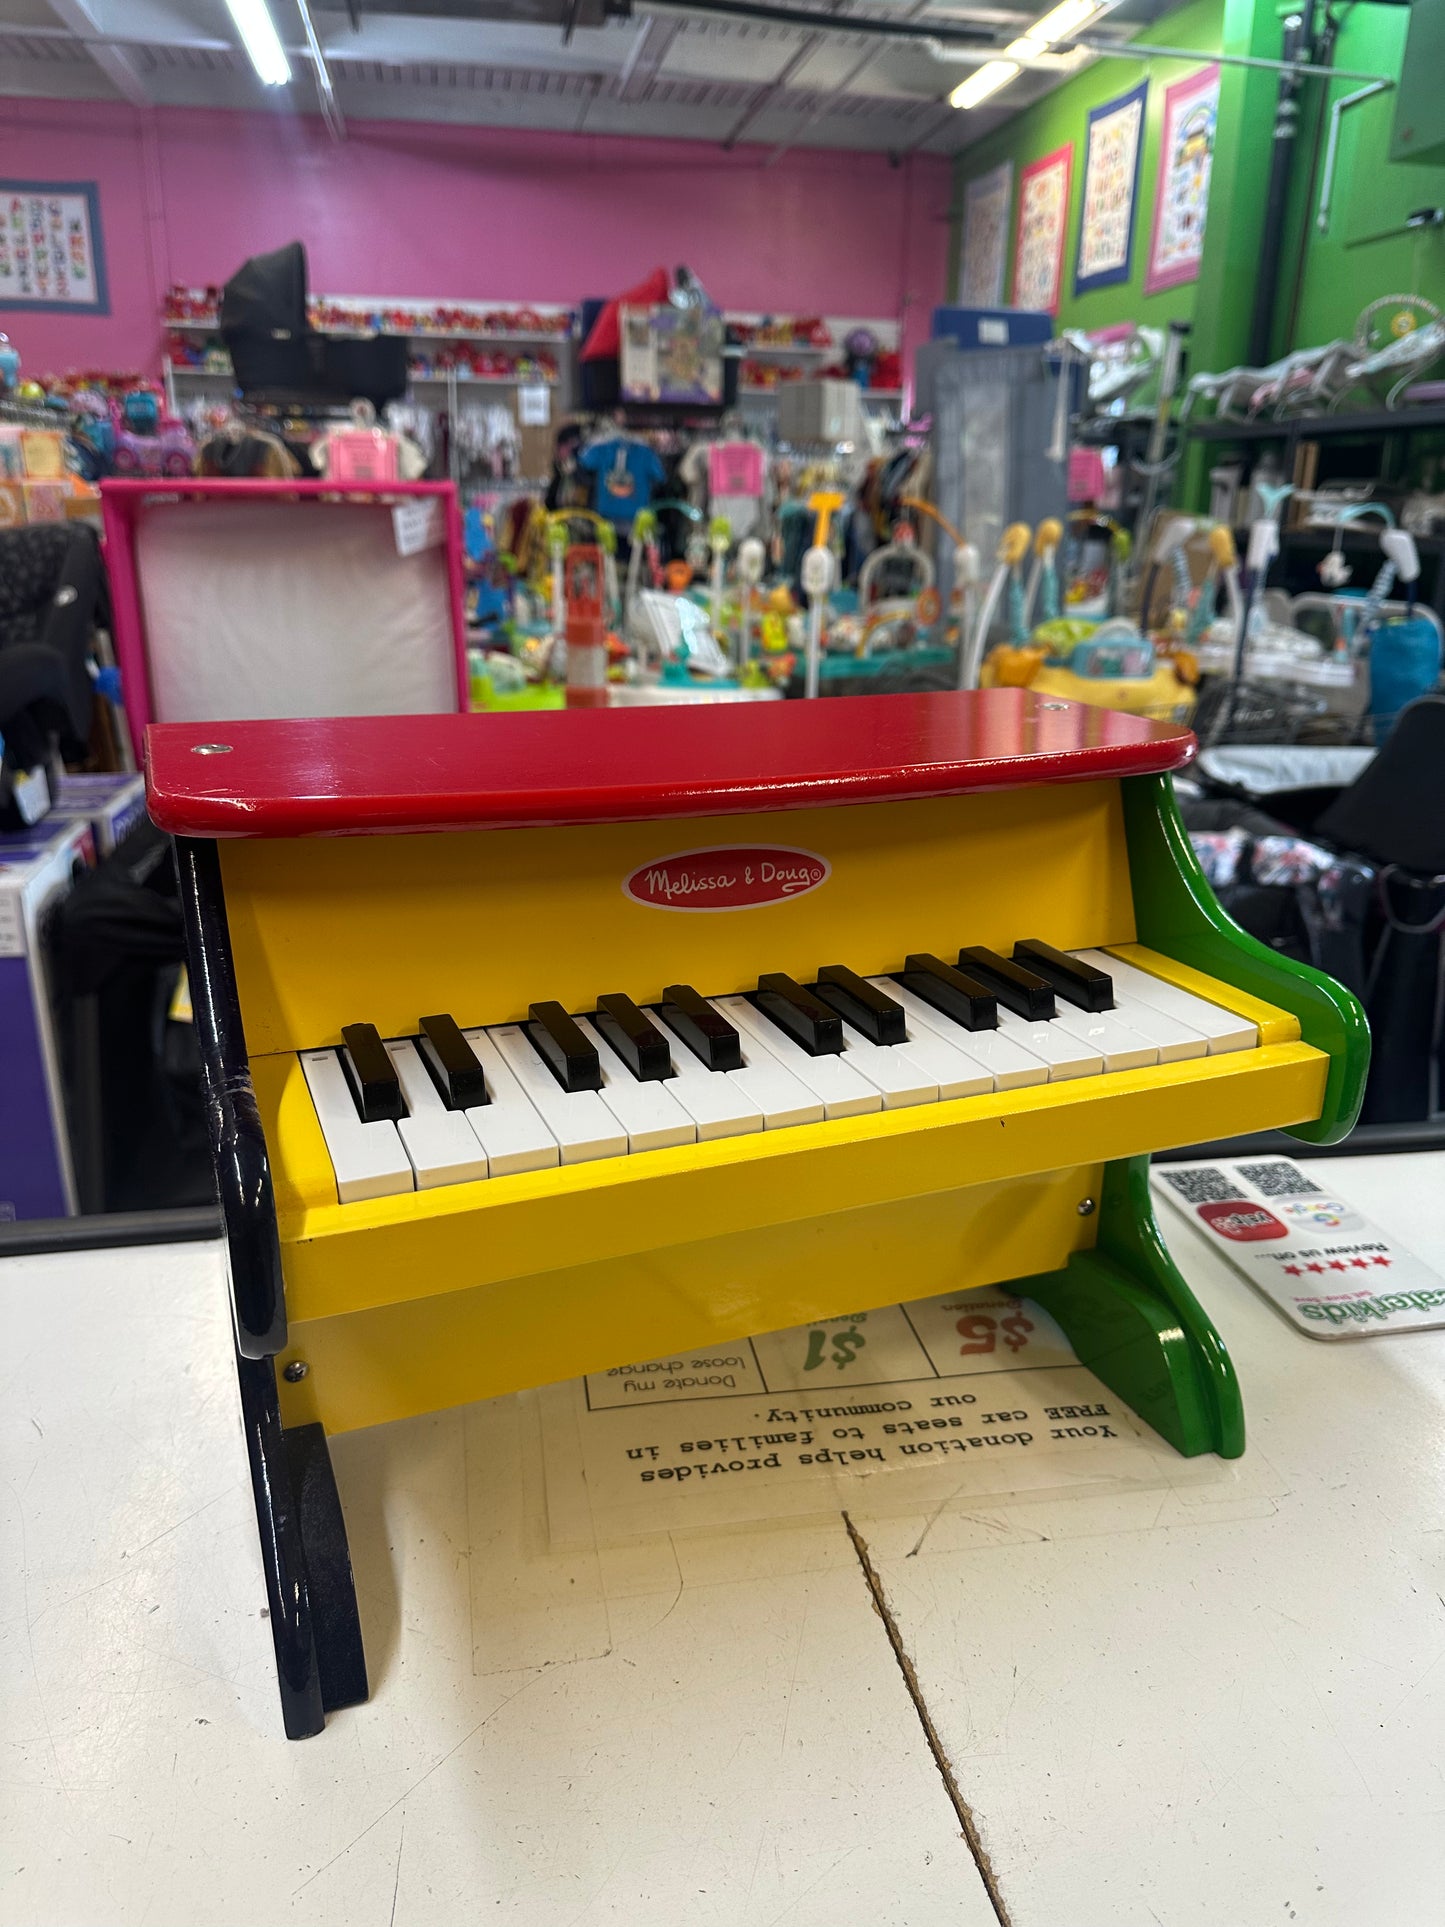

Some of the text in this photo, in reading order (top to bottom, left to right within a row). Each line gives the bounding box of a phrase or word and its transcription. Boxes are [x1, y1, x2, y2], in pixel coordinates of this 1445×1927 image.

[645, 865, 736, 900] Melissa
[744, 865, 755, 885] &
[1283, 1202, 1345, 1215] Google
[1301, 1248, 1323, 1259] us
[1324, 1242, 1390, 1256] Review
[803, 1325, 866, 1371] $1
[955, 1310, 1035, 1357] $5
[607, 1356, 746, 1376] loose change
[624, 1375, 737, 1392] Donate my
[754, 1393, 977, 1423] our community.
[626, 1403, 1111, 1461] FREE car seats to families in
[640, 1424, 1118, 1483] Your donation helps provides
